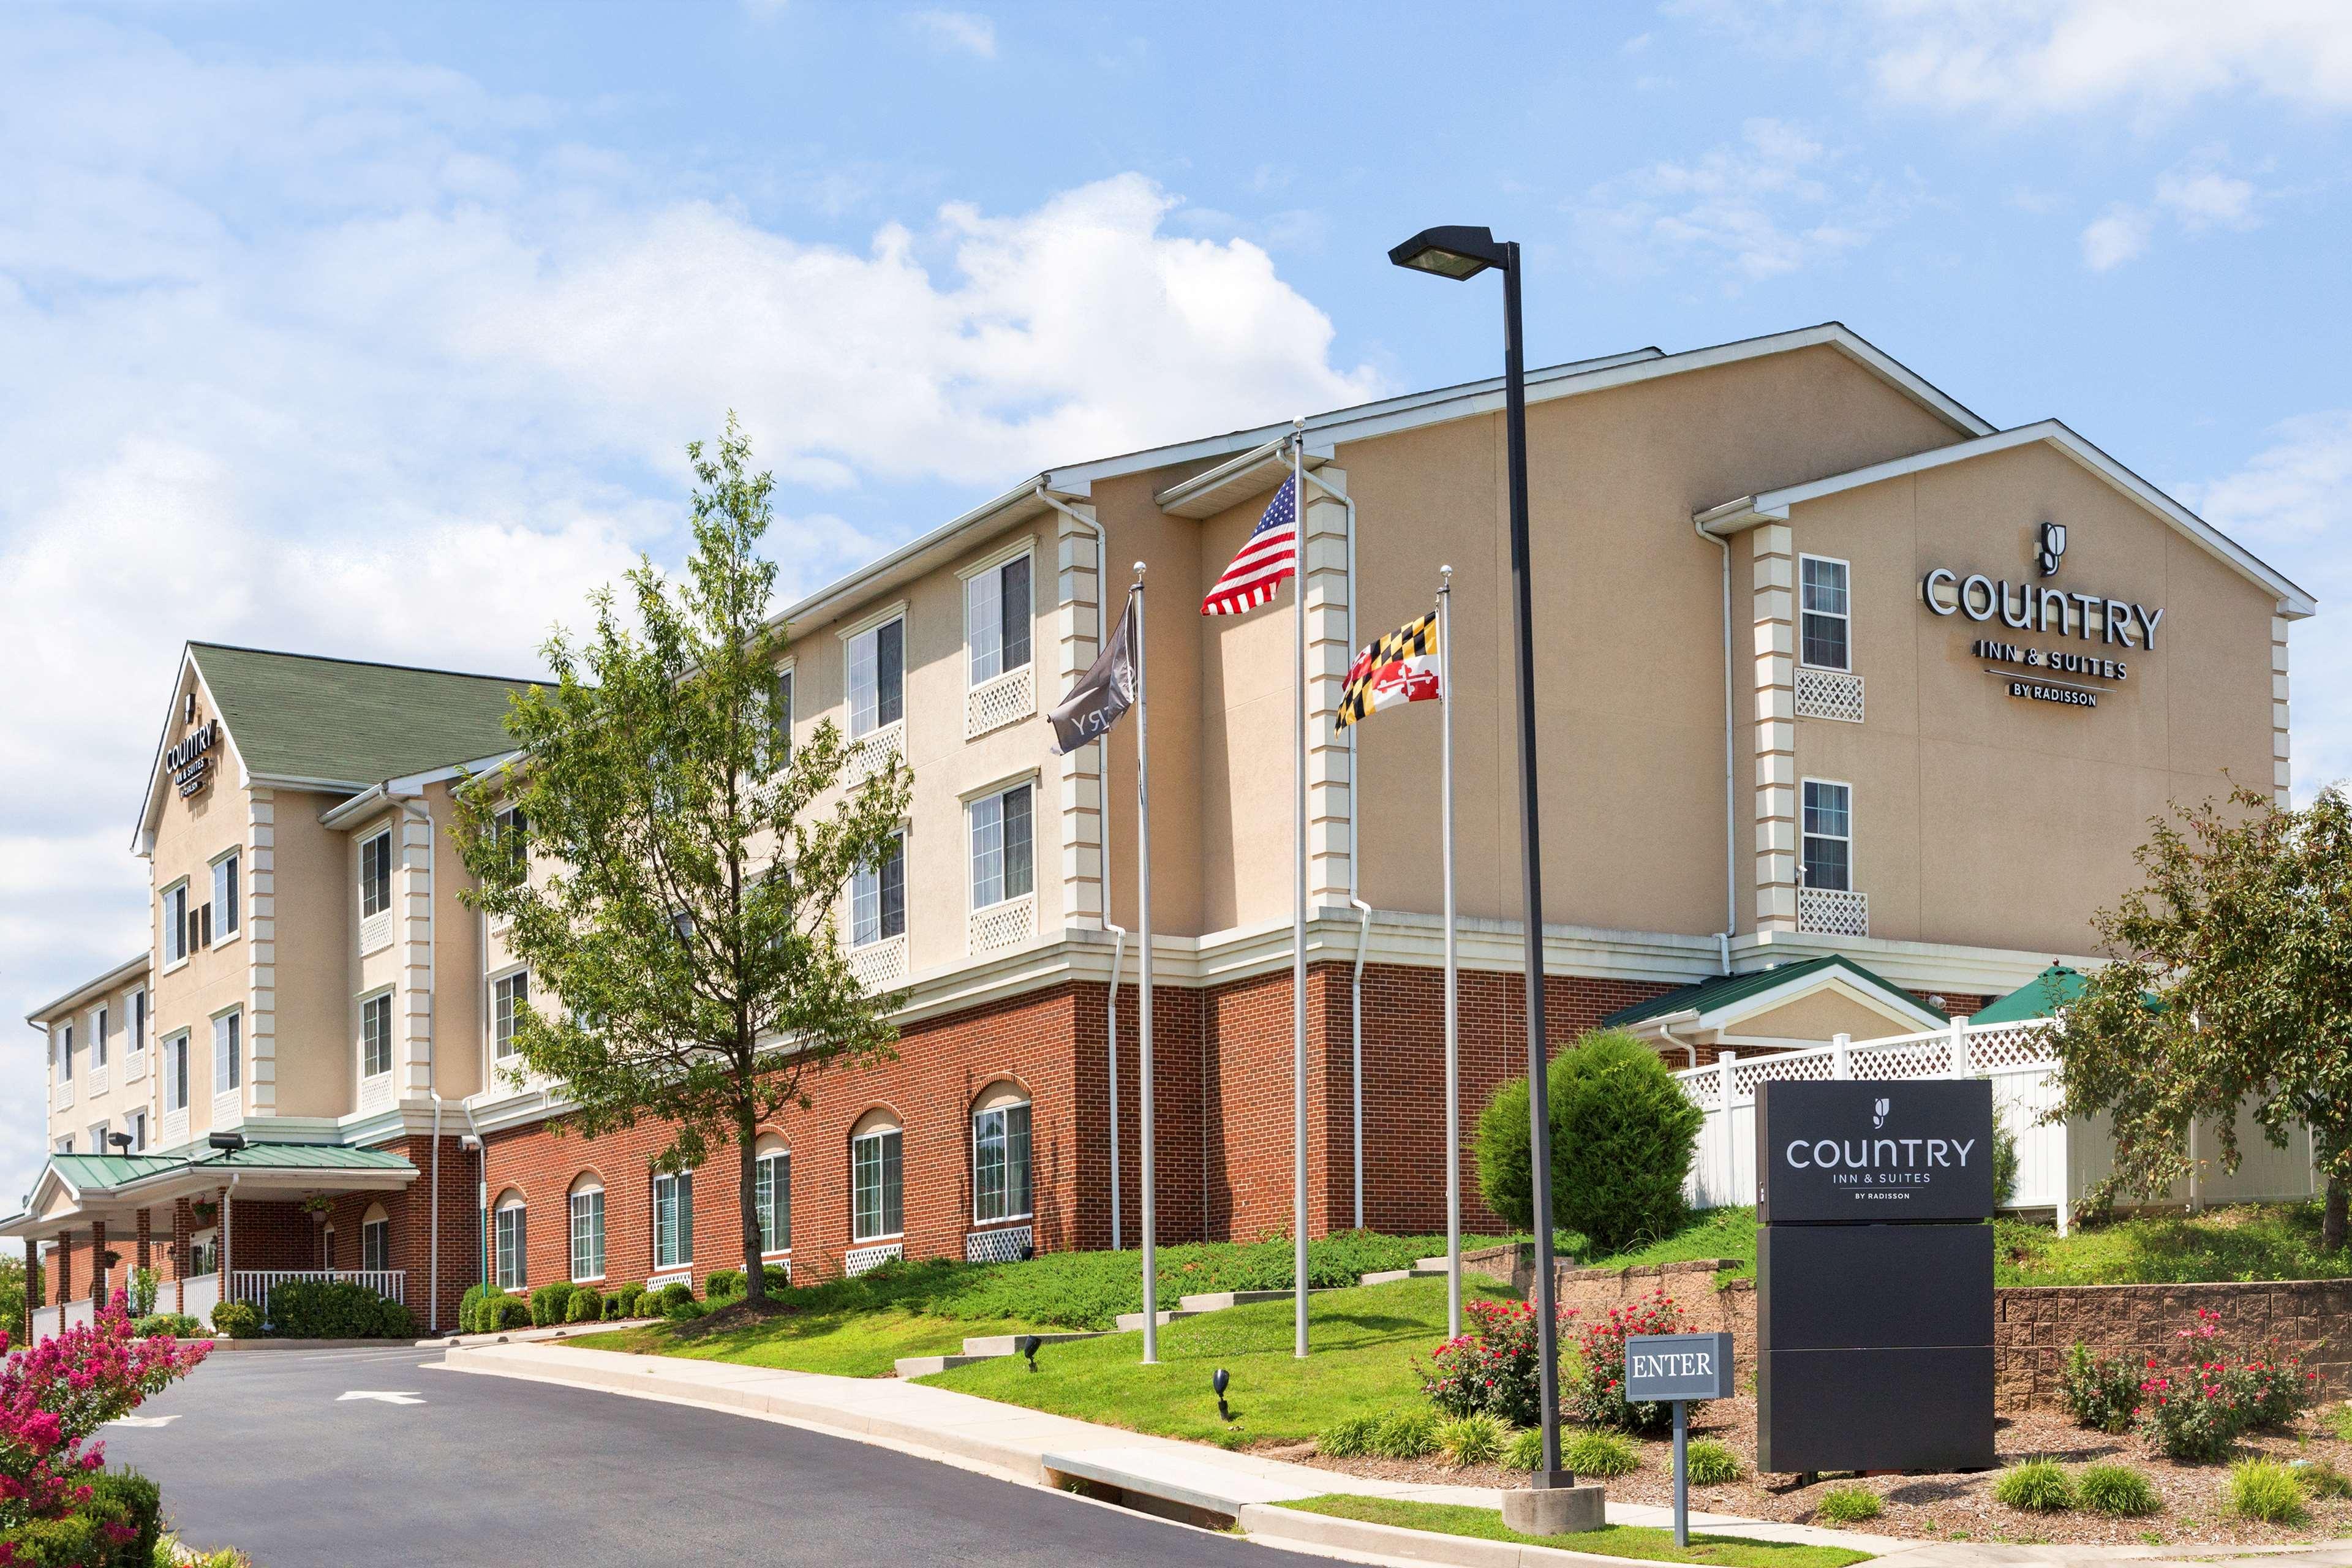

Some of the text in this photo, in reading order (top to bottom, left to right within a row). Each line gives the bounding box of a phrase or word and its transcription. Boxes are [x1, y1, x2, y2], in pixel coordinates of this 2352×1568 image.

[1923, 568, 2165, 650] COUNTRY
[1976, 639, 2127, 680] INN & SUITES
[2013, 683, 2097, 706] BY RADISSON
[166, 722, 213, 774] COUNTRY
[187, 757, 204, 776] SUITES
[1786, 1139, 1975, 1169] COUNTRY
[1833, 1173, 1931, 1183] INN & SUITES
[1632, 1352, 1713, 1378] ENTER
